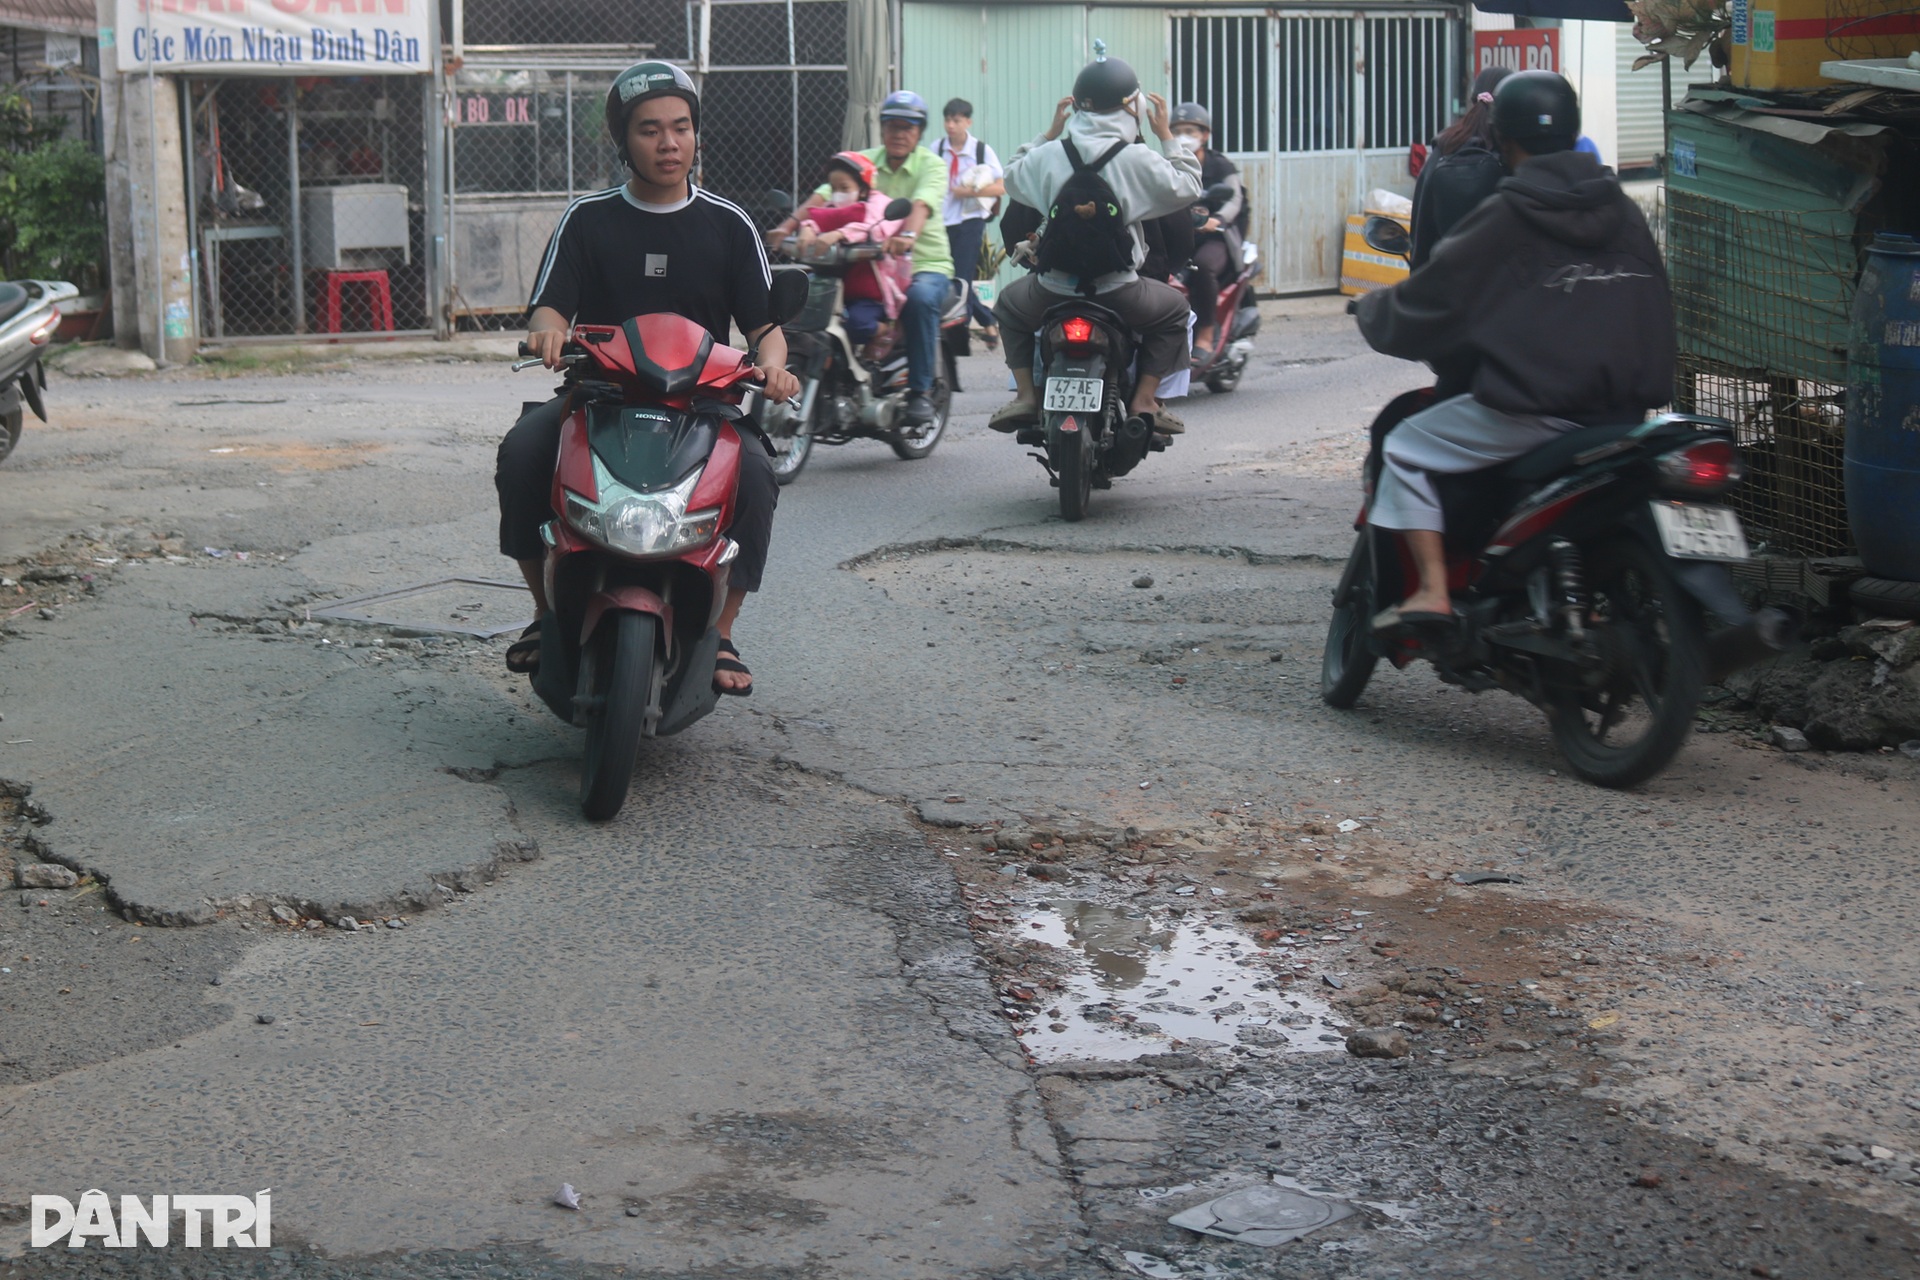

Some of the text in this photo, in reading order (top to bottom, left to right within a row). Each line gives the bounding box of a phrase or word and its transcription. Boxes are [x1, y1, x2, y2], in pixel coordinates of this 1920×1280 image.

[133, 26, 420, 66] Các Món Nhậu Bình Dân
[506, 97, 529, 122] OK
[1055, 380, 1093, 395] 47-AE
[1050, 395, 1097, 409] 137.14
[634, 413, 671, 422] HONDA
